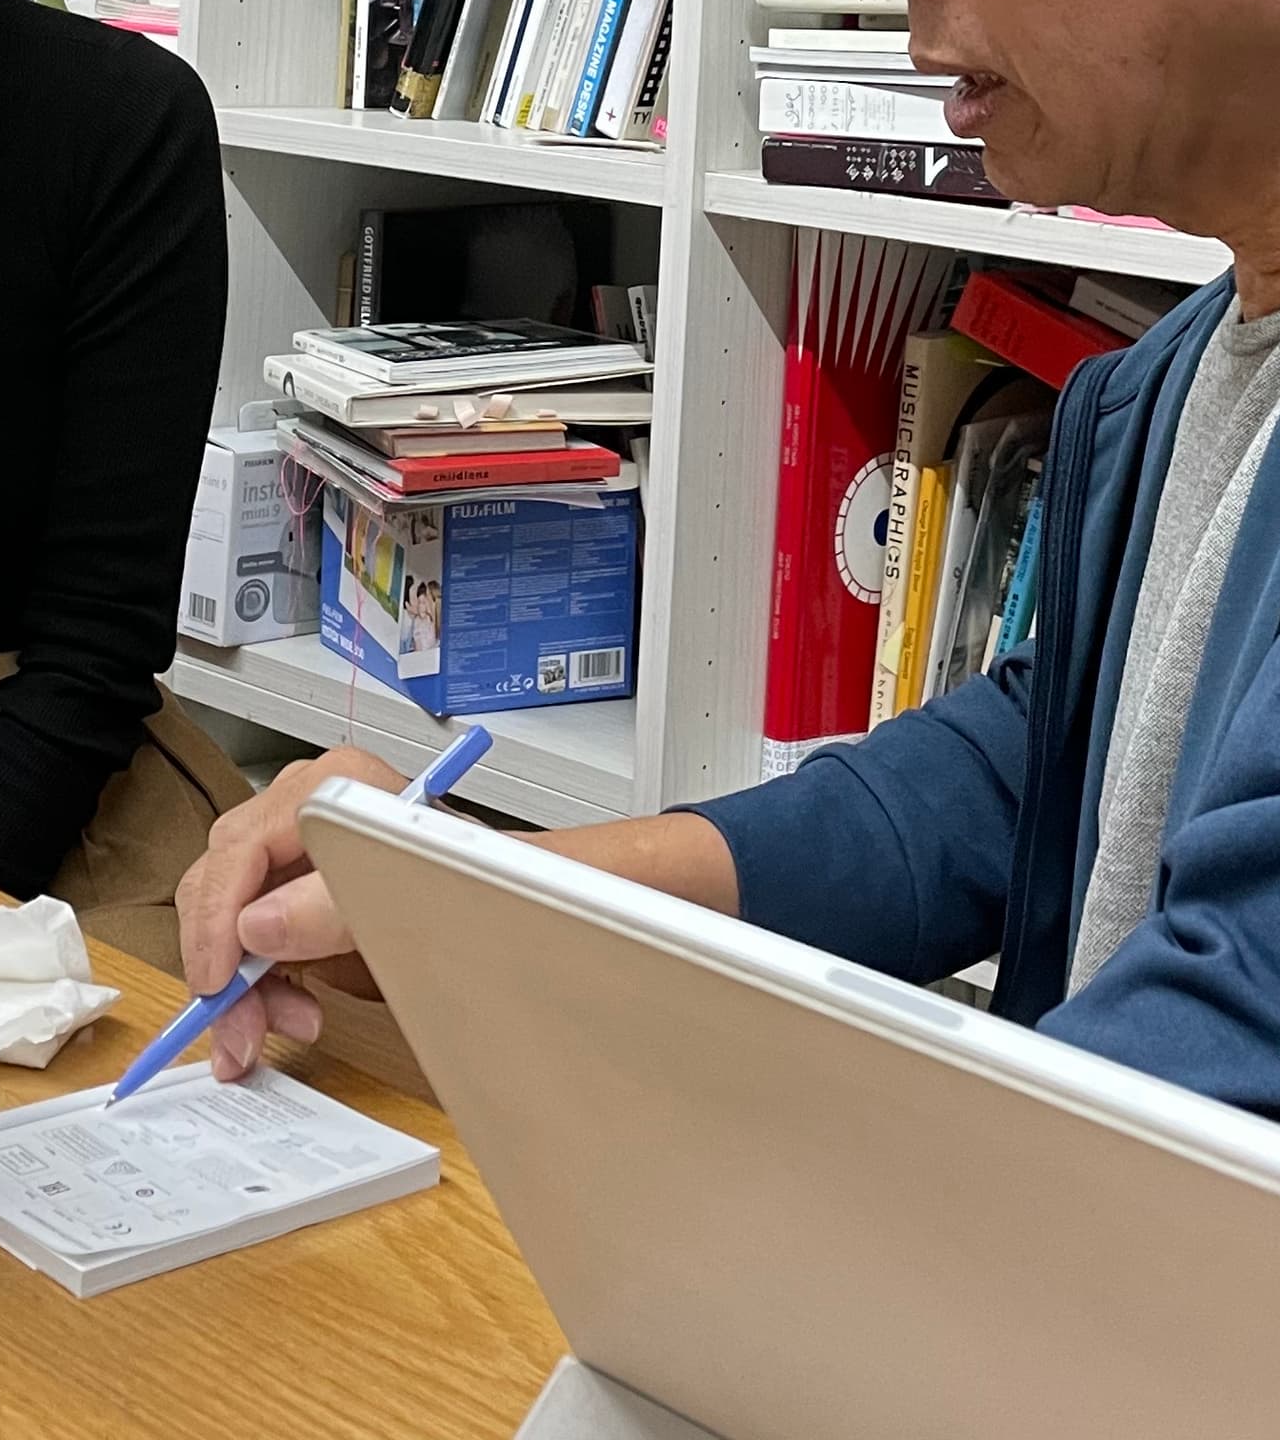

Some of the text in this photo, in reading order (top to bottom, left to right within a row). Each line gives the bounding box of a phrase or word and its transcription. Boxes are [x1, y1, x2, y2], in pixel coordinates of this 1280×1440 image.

[584, 0, 618, 78] MAGAZINE
[360, 226, 375, 293] GOTTFRIED
[241, 504, 281, 521] mini 9
[451, 501, 516, 519] FUJIFILM
